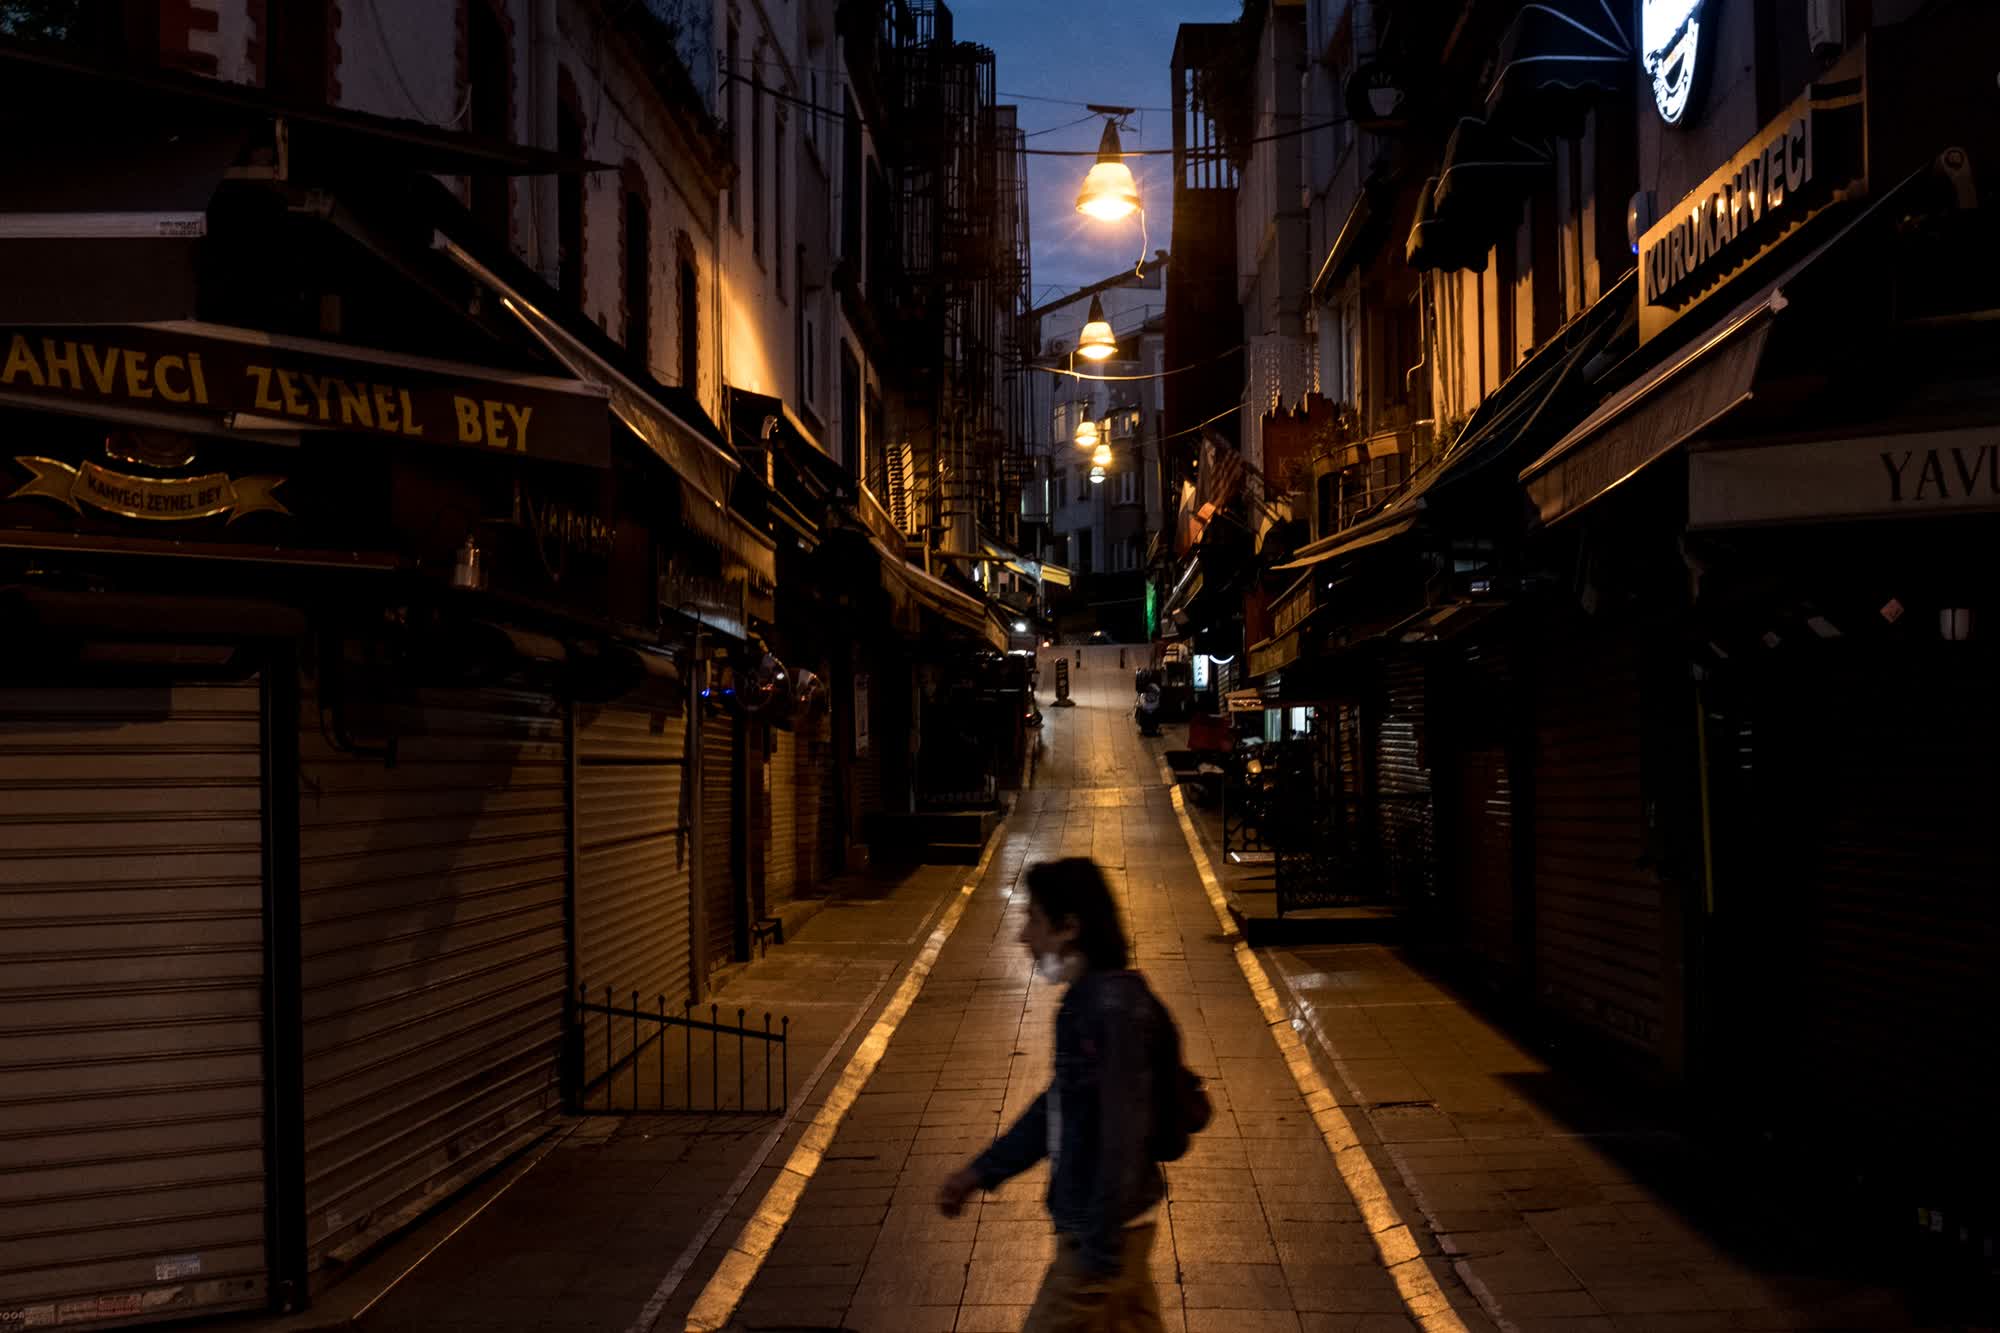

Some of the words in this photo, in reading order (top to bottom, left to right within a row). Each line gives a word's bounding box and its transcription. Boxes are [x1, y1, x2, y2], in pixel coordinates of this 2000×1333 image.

[246, 365, 424, 436] ZEYNEL
[453, 394, 534, 452] BEY
[147, 491, 194, 512] ZEYNEL
[198, 485, 223, 506] BEY
